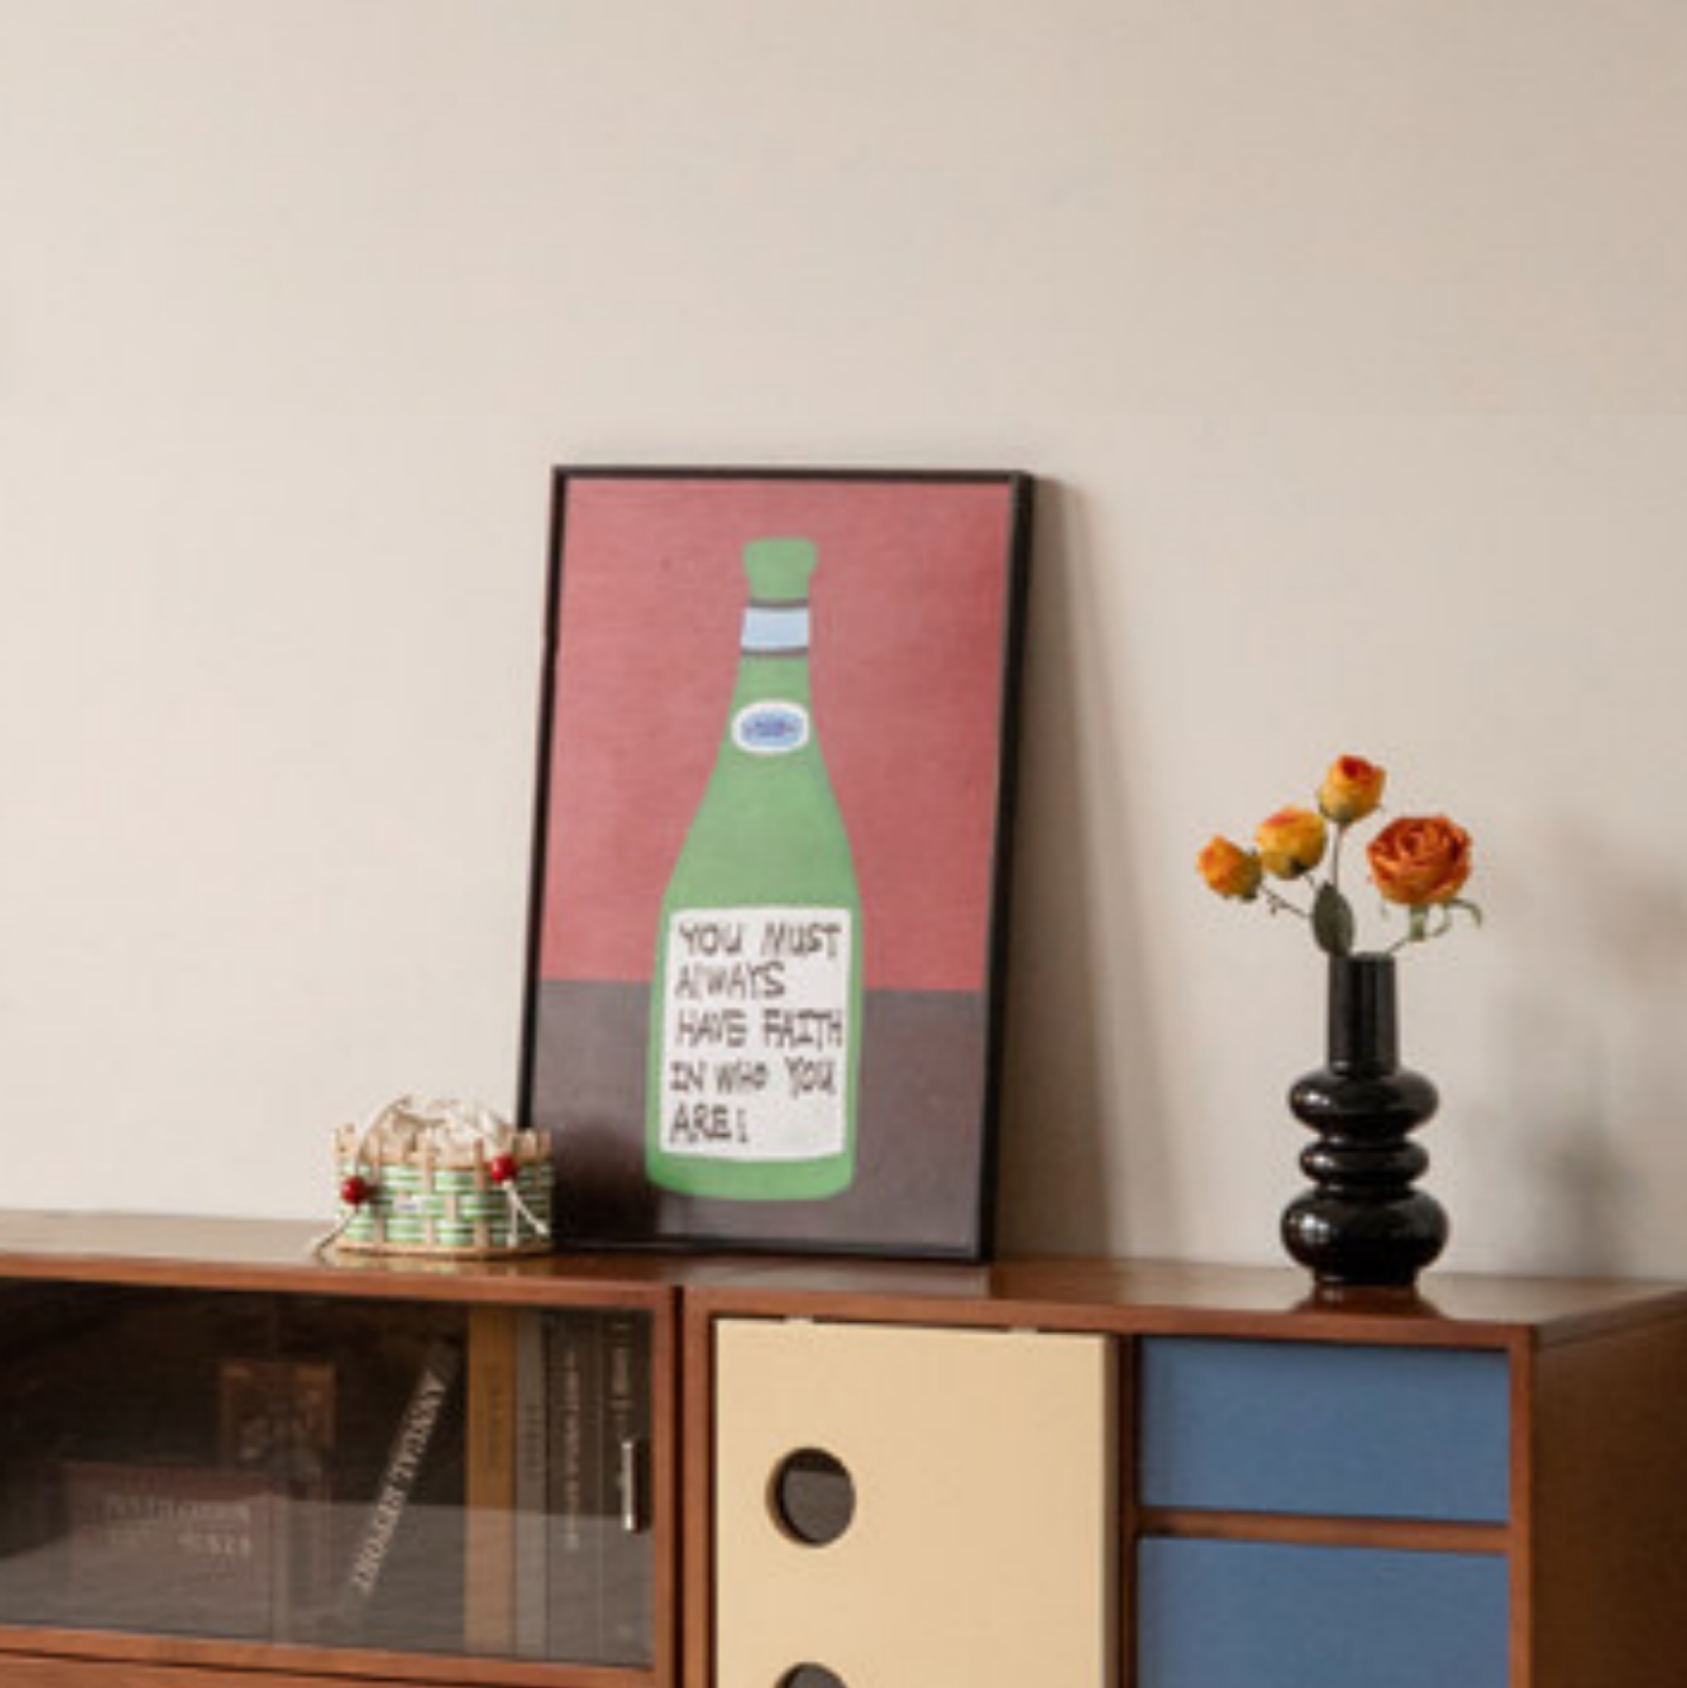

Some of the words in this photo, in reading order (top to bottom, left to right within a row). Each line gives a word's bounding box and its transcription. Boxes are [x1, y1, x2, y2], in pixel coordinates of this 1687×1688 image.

[679, 922, 742, 956] YOU
[760, 922, 842, 959] MUST
[675, 1008, 747, 1048] HAVE
[763, 1008, 843, 1051] FAITH
[670, 1060, 706, 1092] IN
[713, 1060, 768, 1094] WHO
[784, 1056, 836, 1099] YOU
